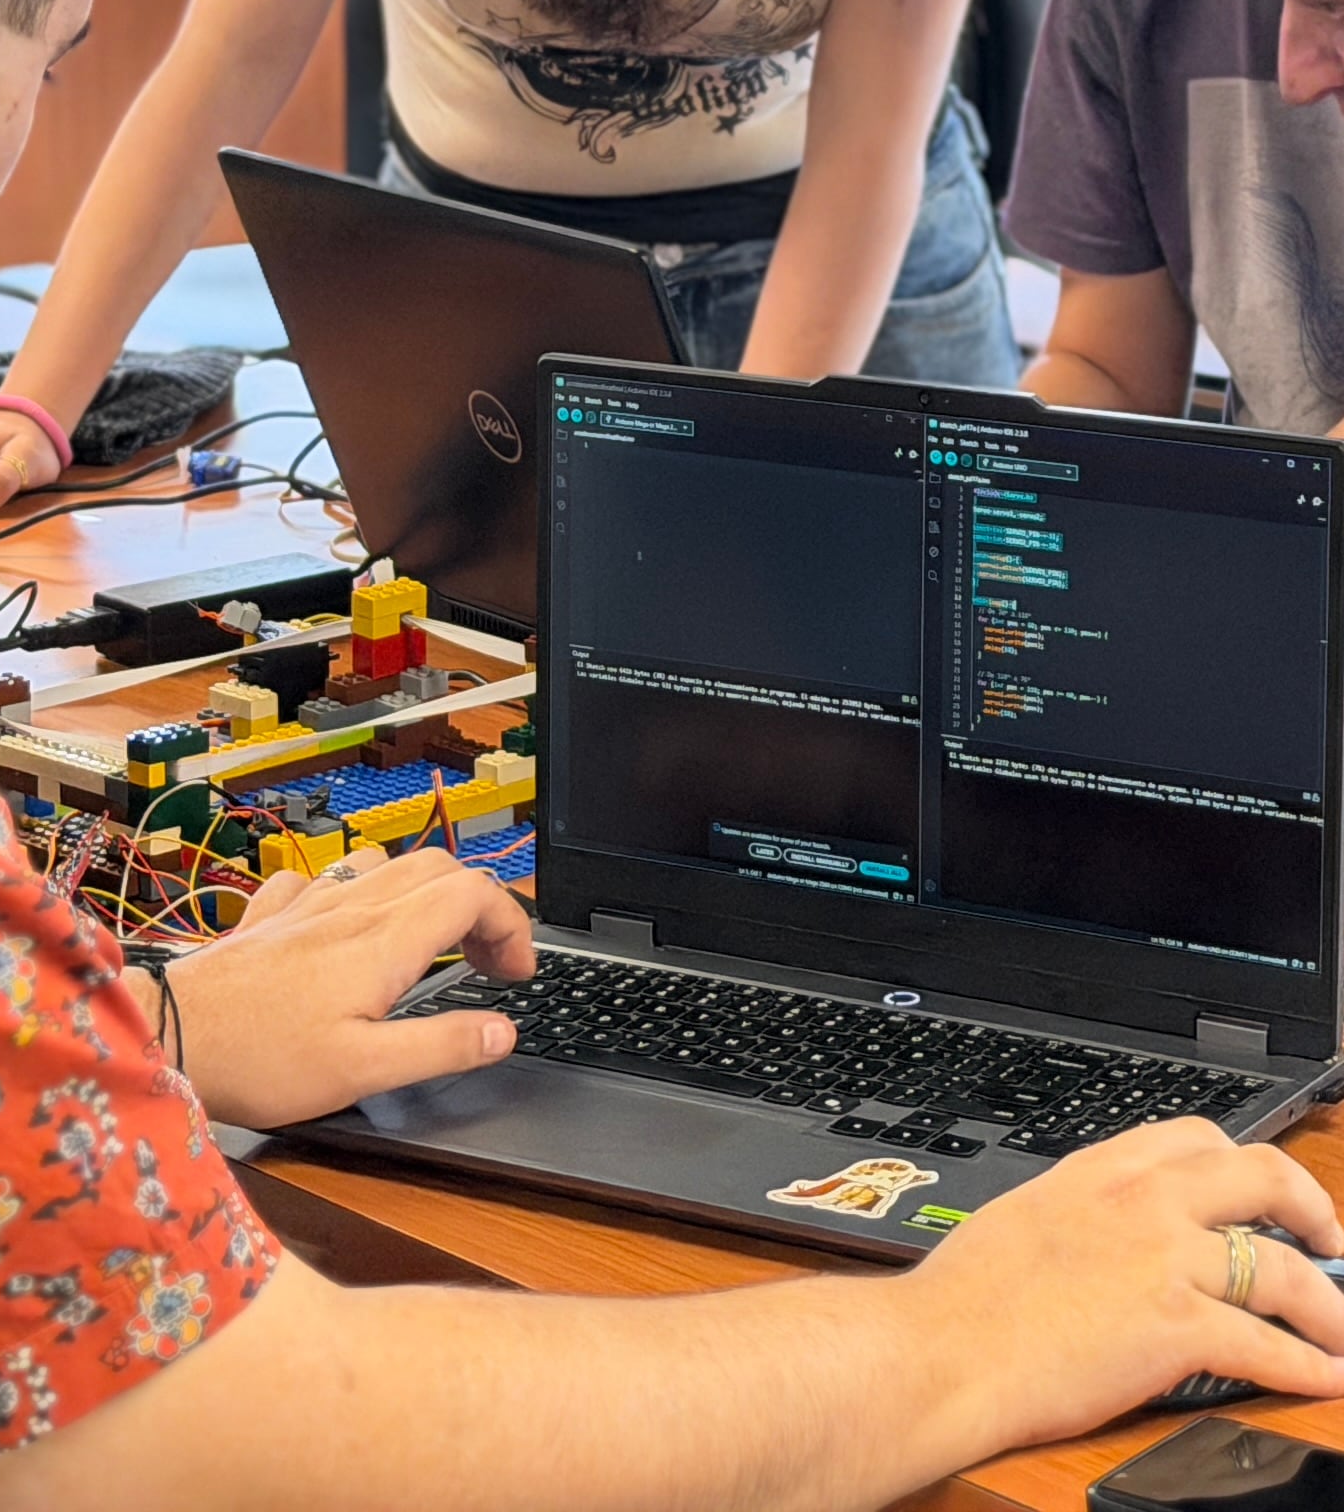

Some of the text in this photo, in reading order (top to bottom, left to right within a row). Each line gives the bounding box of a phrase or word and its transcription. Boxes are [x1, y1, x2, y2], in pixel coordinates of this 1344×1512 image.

[625, 401, 639, 410] Help
[476, 413, 516, 440] DELL
[960, 439, 978, 447] Sketch
[1004, 444, 1018, 453] Help
